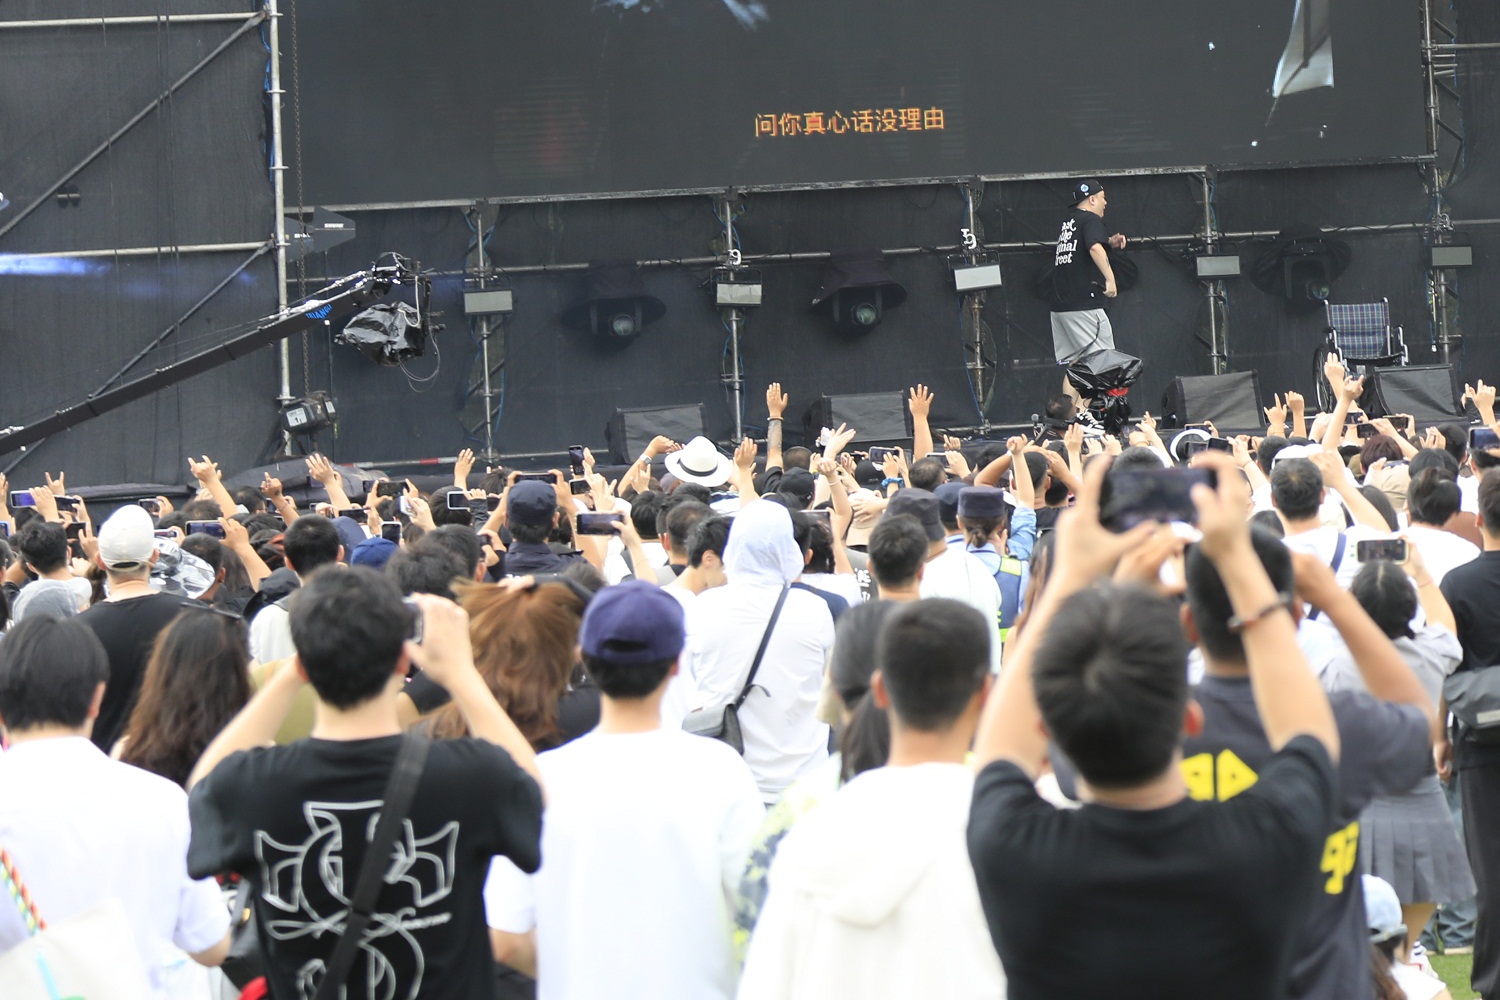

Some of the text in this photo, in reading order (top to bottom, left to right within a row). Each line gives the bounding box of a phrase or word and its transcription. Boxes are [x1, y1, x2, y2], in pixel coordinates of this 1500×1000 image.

[755, 106, 945, 137] 问你真心话没理由
